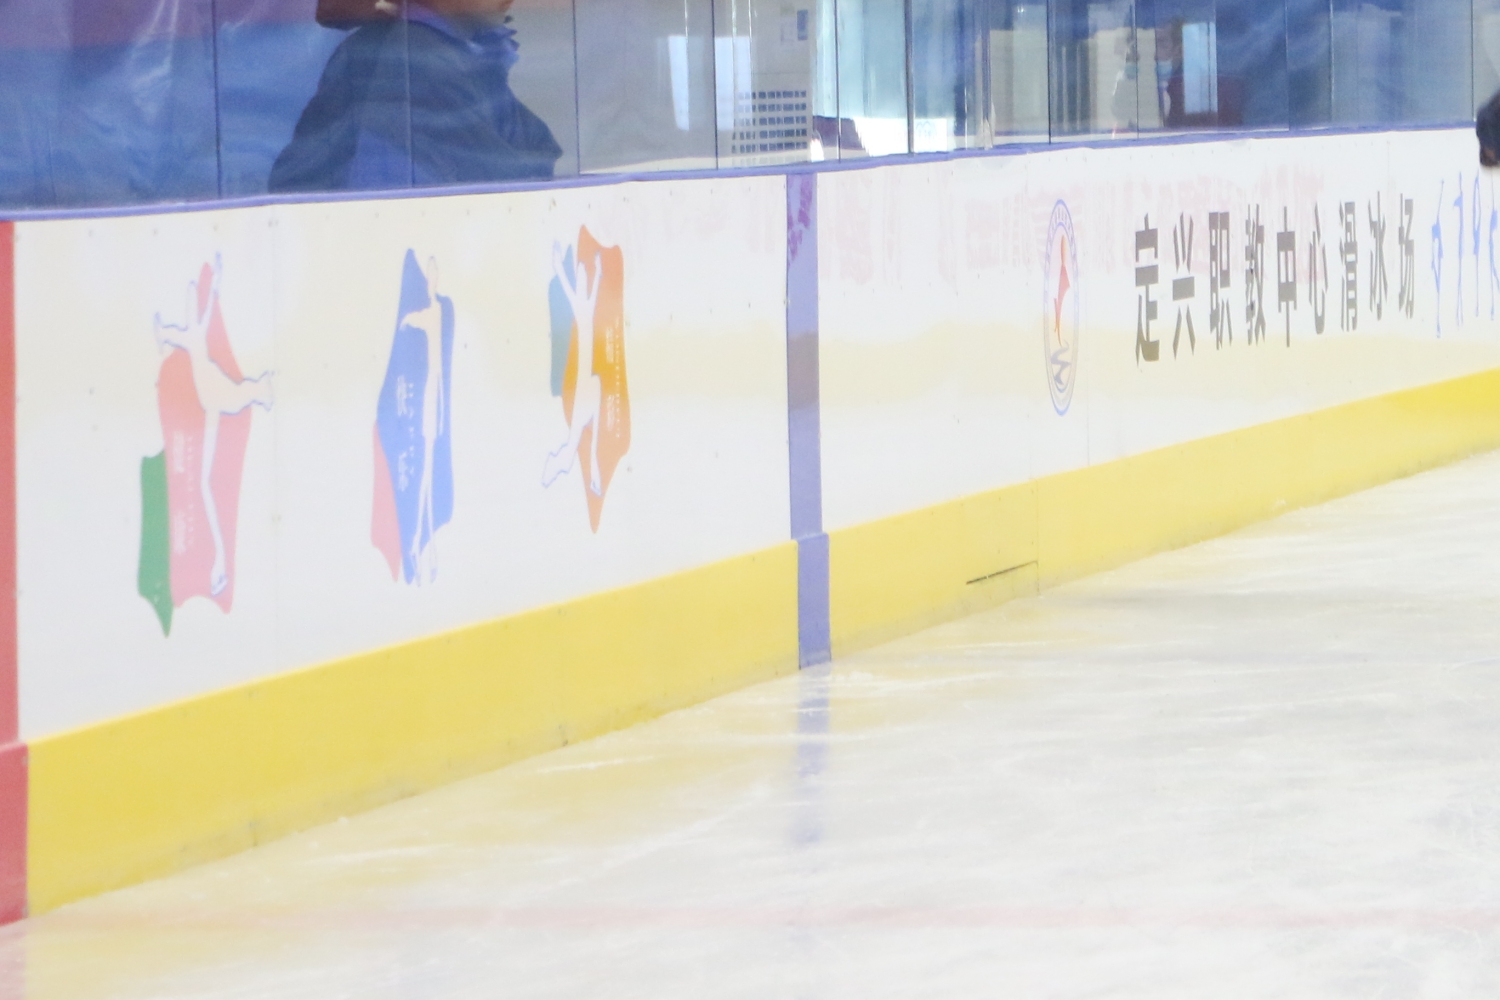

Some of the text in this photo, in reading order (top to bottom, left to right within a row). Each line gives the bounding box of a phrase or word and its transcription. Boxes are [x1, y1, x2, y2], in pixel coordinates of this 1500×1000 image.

[1134, 190, 1416, 364] 定兴职教中心滑冰场
